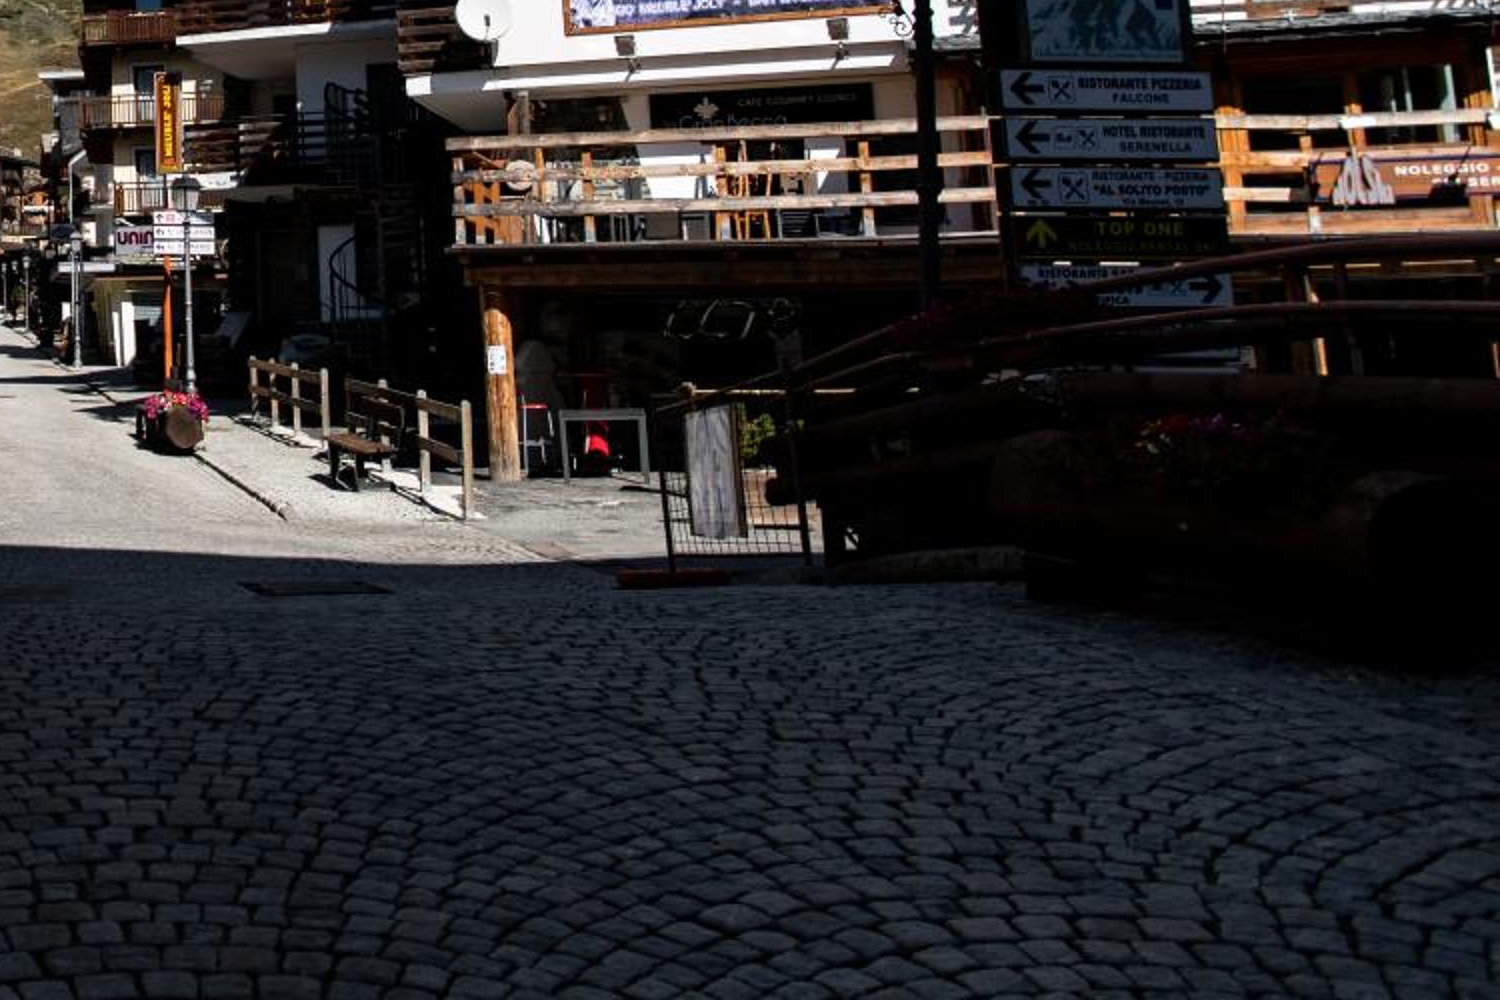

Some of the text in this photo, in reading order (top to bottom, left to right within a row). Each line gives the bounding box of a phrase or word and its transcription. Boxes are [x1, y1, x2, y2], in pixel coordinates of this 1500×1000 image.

[1077, 77, 1202, 90] RISTORANTE PIZZERIA
[1112, 93, 1169, 104] FALCONE
[1103, 126, 1205, 139] HOTEL RISTORANTE
[1119, 142, 1191, 152] SERENELLA
[1394, 162, 1490, 176] NOLEGGIO
[1094, 221, 1185, 236] TOP ONE
